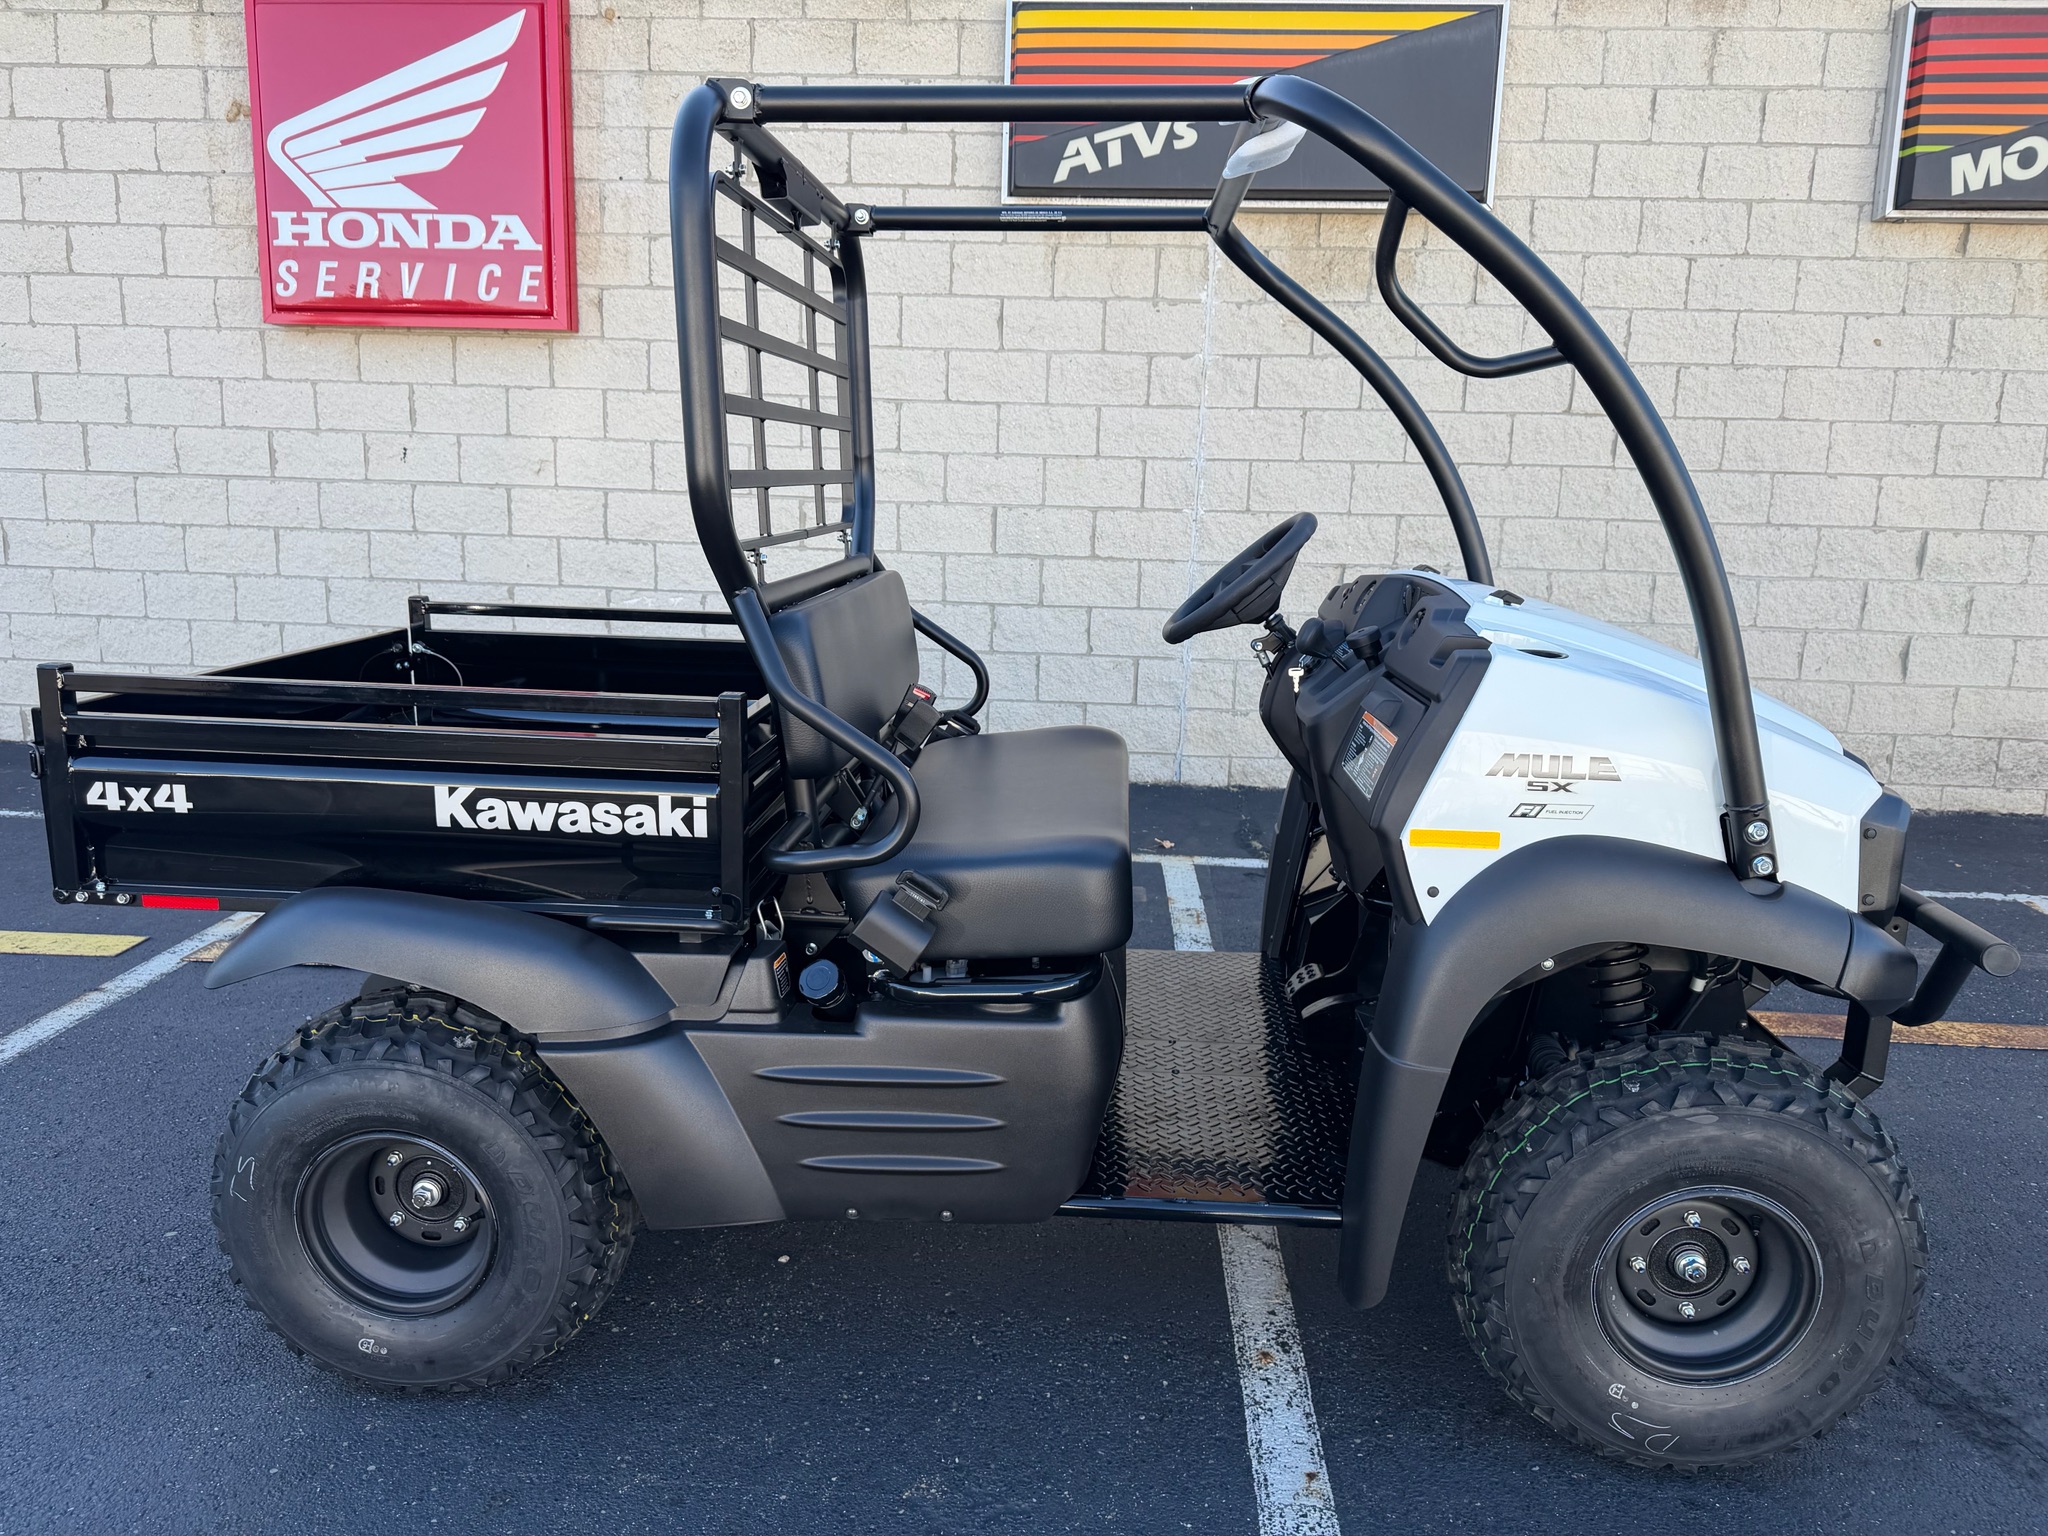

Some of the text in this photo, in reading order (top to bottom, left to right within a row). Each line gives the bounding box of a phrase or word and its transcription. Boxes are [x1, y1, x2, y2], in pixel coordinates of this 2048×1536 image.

[271, 211, 543, 252] HONDA
[276, 259, 543, 303] SERVICE
[1485, 753, 1622, 782] MULE
[86, 780, 194, 814] 4x4
[1526, 780, 1579, 794] SX
[433, 785, 709, 839] Kawasaki
